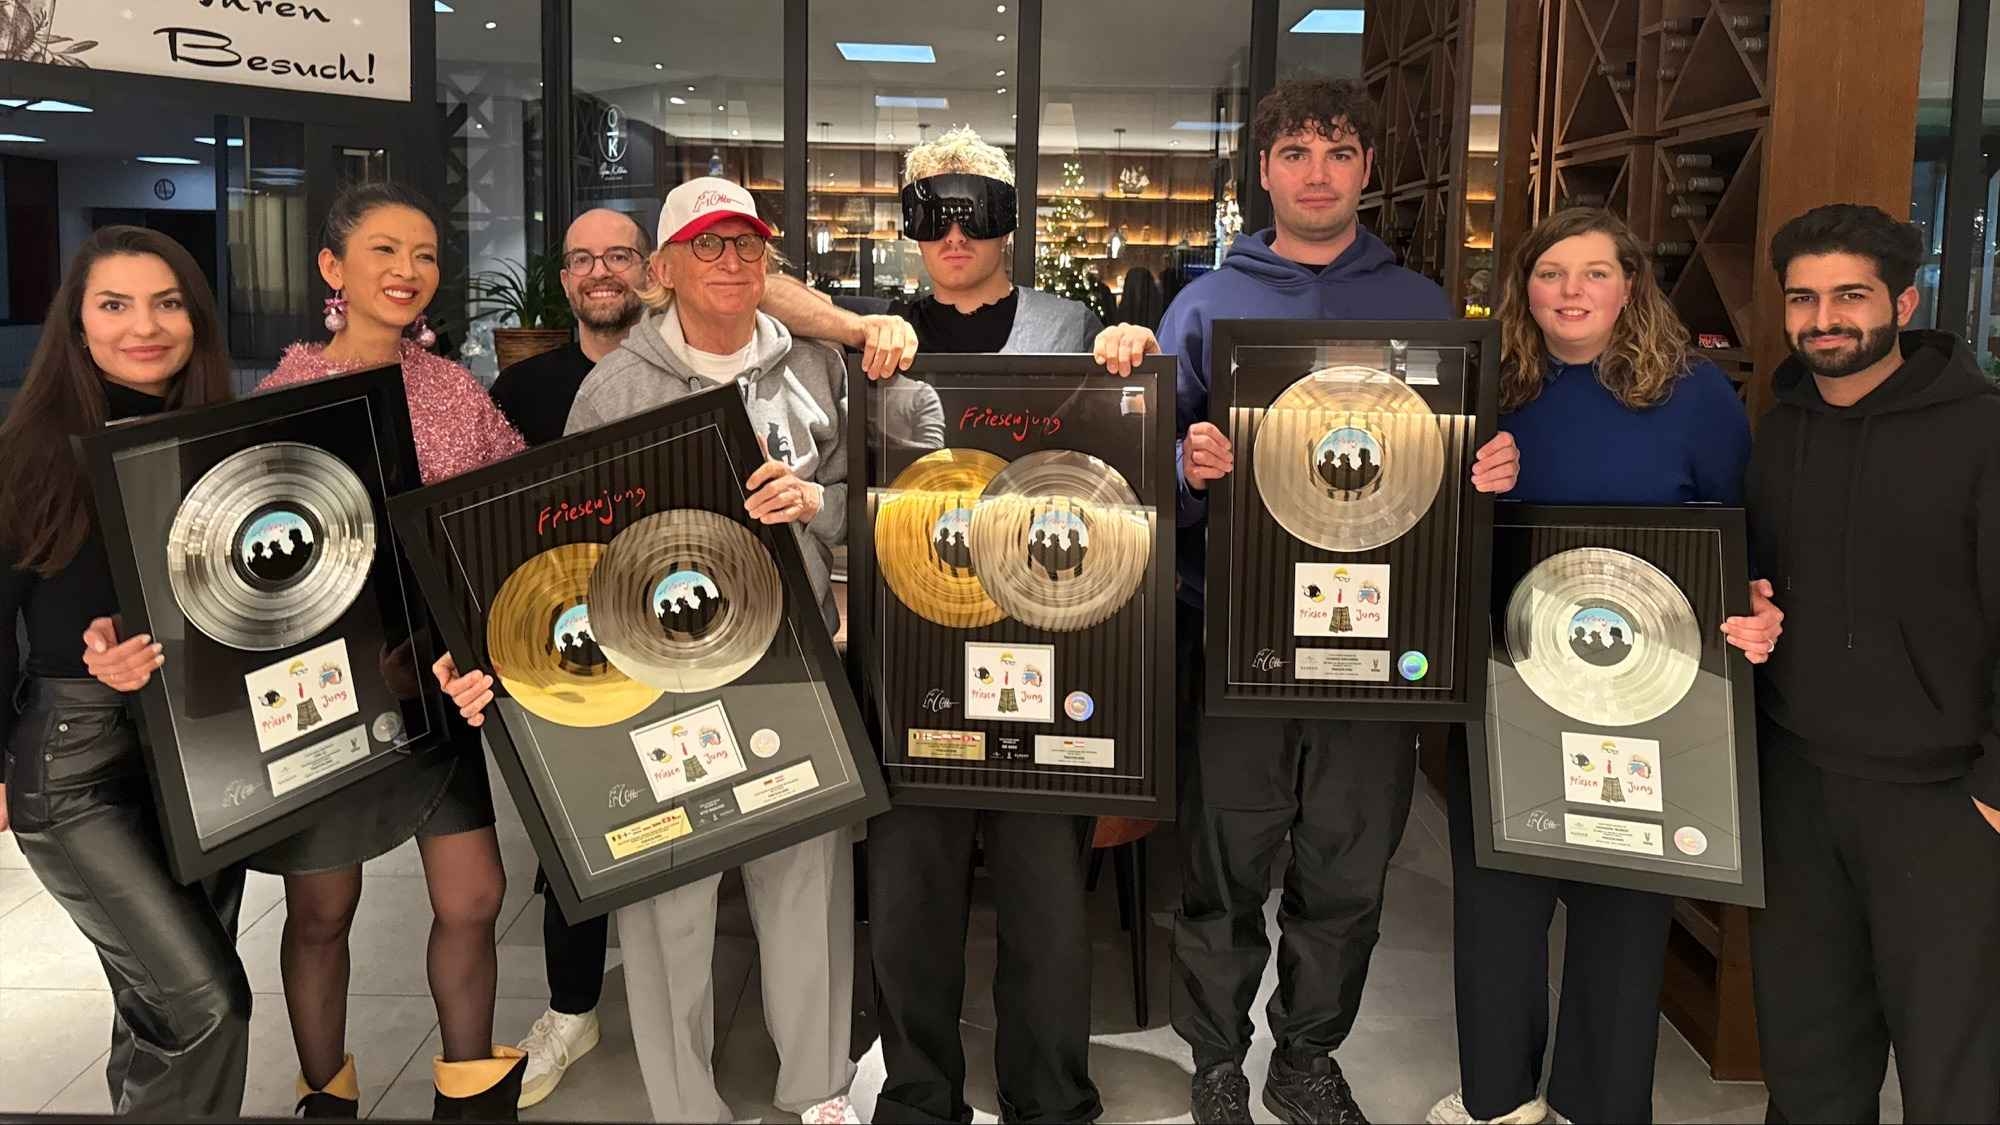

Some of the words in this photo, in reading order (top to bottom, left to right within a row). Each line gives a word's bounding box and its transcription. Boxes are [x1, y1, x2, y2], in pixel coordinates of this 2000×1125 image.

[153, 27, 375, 84] Besuch!
[960, 406, 1061, 441] Friesenjung
[538, 487, 646, 535] Friesenjung
[1356, 609, 1380, 622] Jung
[321, 690, 348, 708] Jung
[1021, 690, 1043, 703] Jung
[703, 750, 728, 764] Jung
[1627, 781, 1653, 795] Jung
